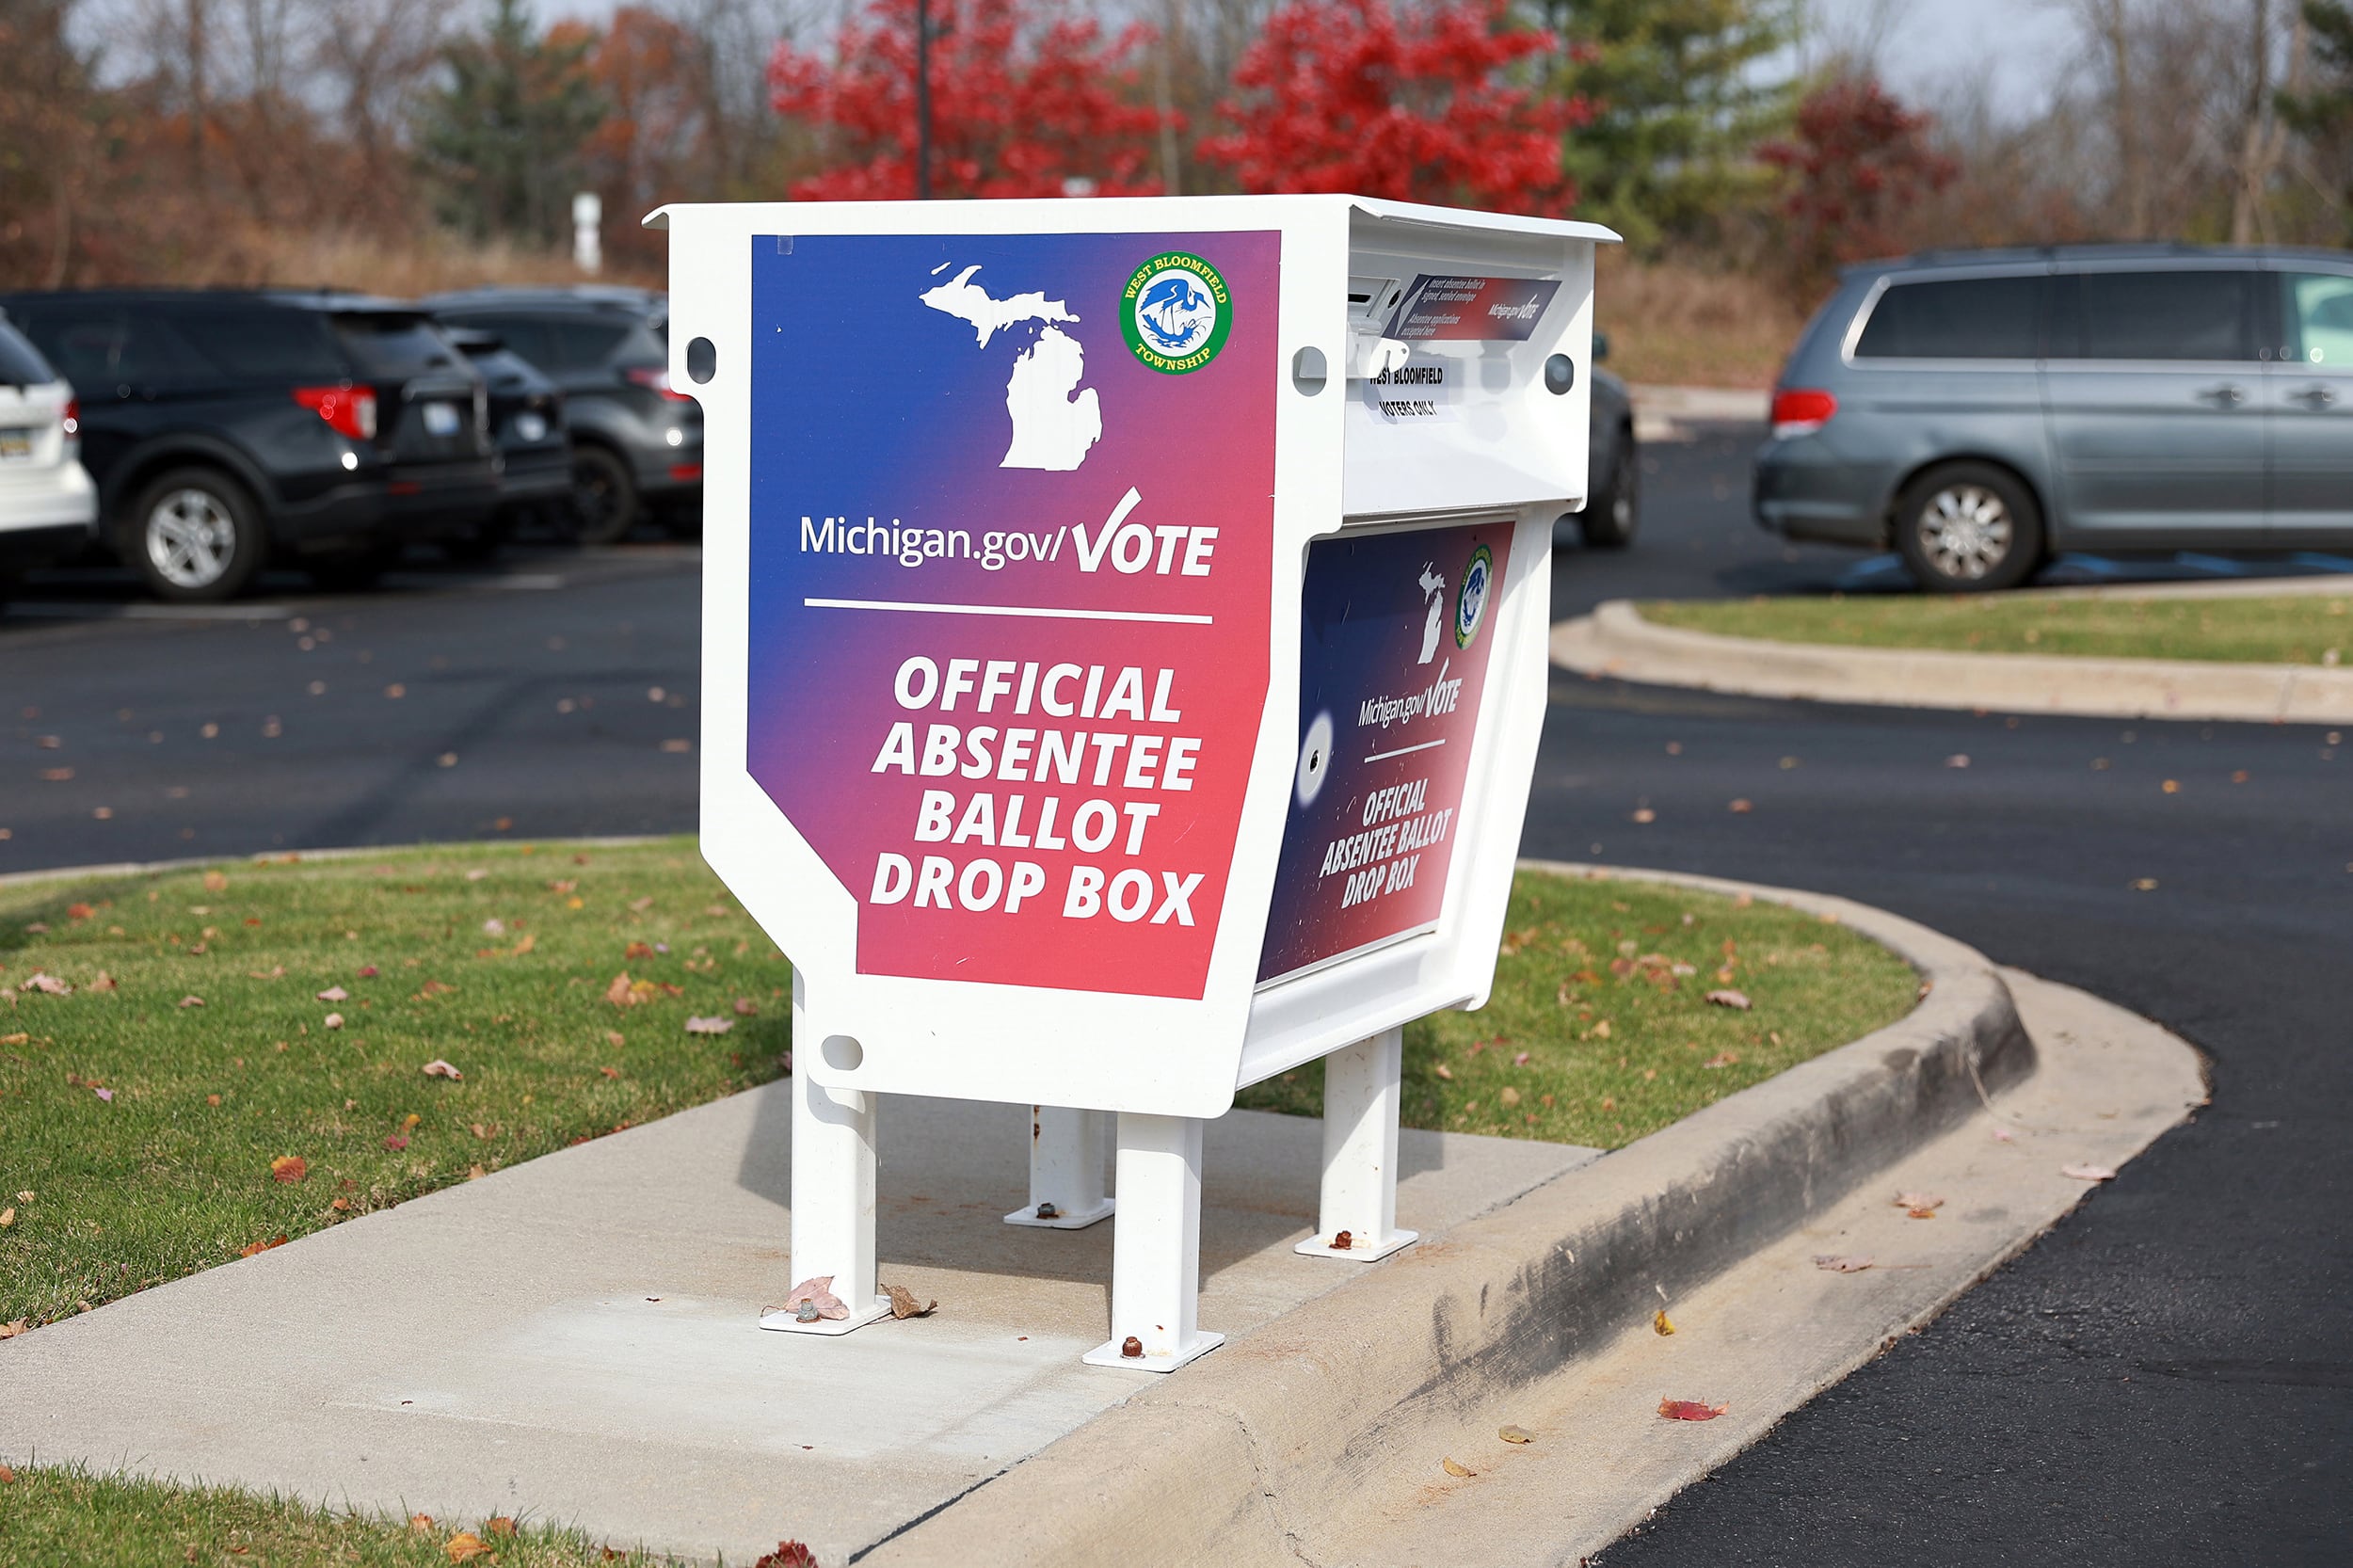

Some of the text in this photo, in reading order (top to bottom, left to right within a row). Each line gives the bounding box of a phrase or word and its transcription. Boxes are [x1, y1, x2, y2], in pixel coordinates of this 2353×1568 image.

[1125, 255, 1227, 304] WEST BLOOMFIELD
[1135, 343, 1211, 371] TOWNSHIP
[1394, 367, 1443, 385] BLOOMFIELD
[1379, 400, 1437, 417] VOTERS ONLY
[893, 655, 1182, 723] OFFICIAL
[870, 721, 1203, 792] ABSENTEE
[913, 789, 1161, 856] BALLOT
[1362, 778, 1429, 826] OFFICIAL
[1319, 808, 1453, 878] ABSENTEE BALLOT
[869, 851, 1206, 927] DROP BOX
[1341, 854, 1420, 909] DROP BOX
